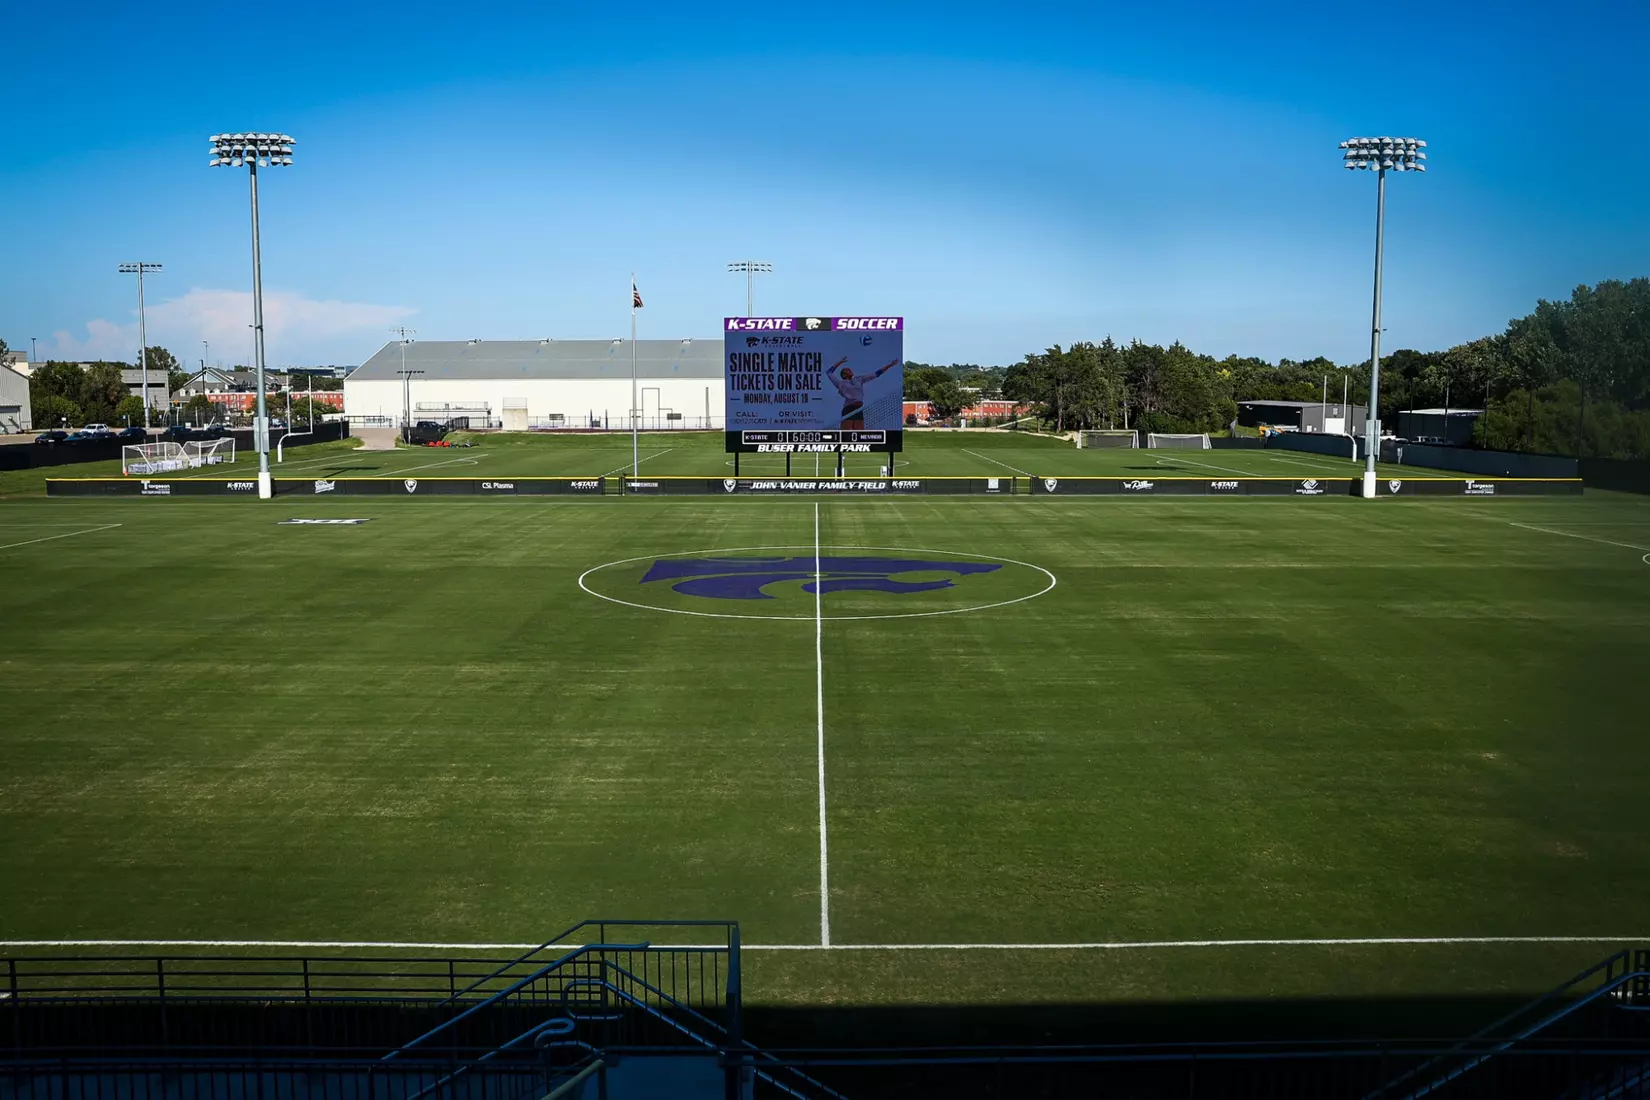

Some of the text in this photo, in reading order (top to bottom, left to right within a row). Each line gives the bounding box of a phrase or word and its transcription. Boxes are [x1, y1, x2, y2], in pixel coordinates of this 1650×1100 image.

[727, 318, 793, 330] K-STATE
[836, 318, 898, 330] SOCCER
[761, 336, 804, 345] K-STATE
[729, 352, 822, 372] SINGLE MATCH
[731, 373, 822, 391] TICKETS ON SALE
[744, 393, 773, 404] MONDAY,
[774, 393, 801, 404] AUGUST
[777, 432, 784, 442] 0
[792, 432, 821, 442] 60:00
[851, 432, 858, 442] 0
[757, 443, 871, 453] BUSER FAMILY PARK
[750, 481, 886, 490] JOHN VANIER FAMILY FIELD
